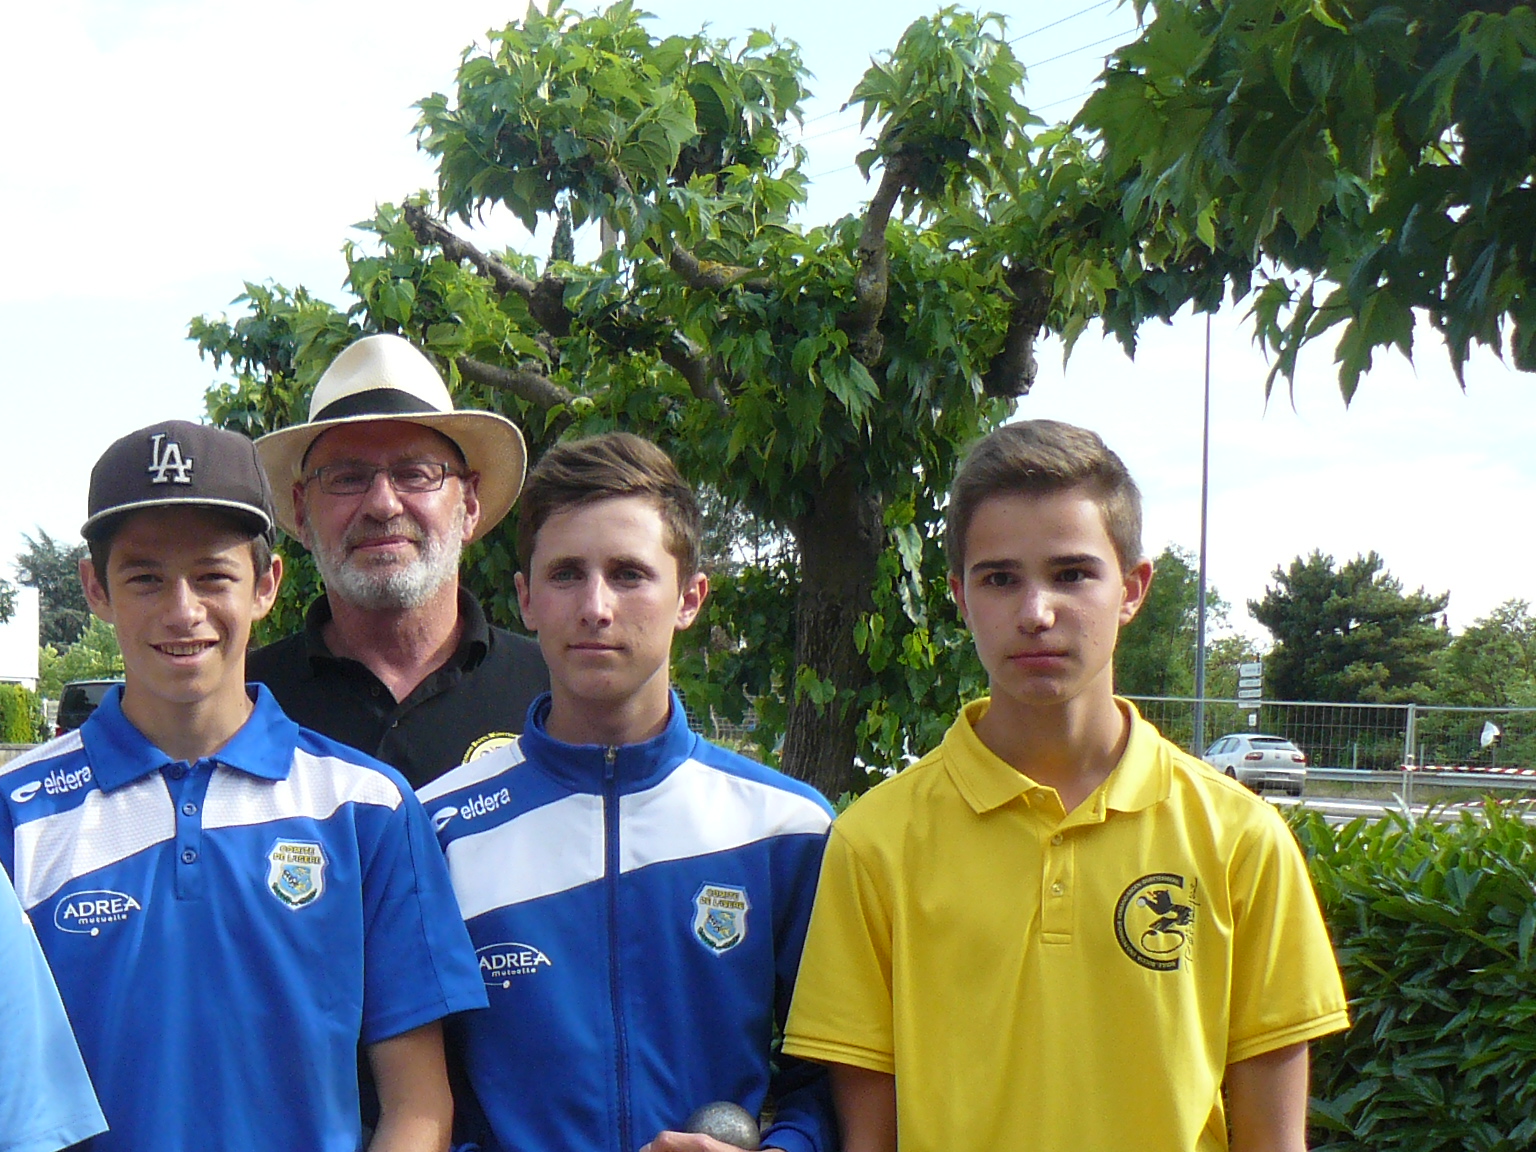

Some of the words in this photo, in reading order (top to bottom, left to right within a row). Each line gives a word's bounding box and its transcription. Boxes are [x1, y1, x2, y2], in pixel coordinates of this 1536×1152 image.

[148, 433, 192, 483] LA
[44, 766, 92, 795] eldera
[460, 787, 511, 820] eldera
[64, 896, 141, 919] ADREA
[78, 913, 128, 926] mutuelle
[480, 951, 551, 972] ADREA
